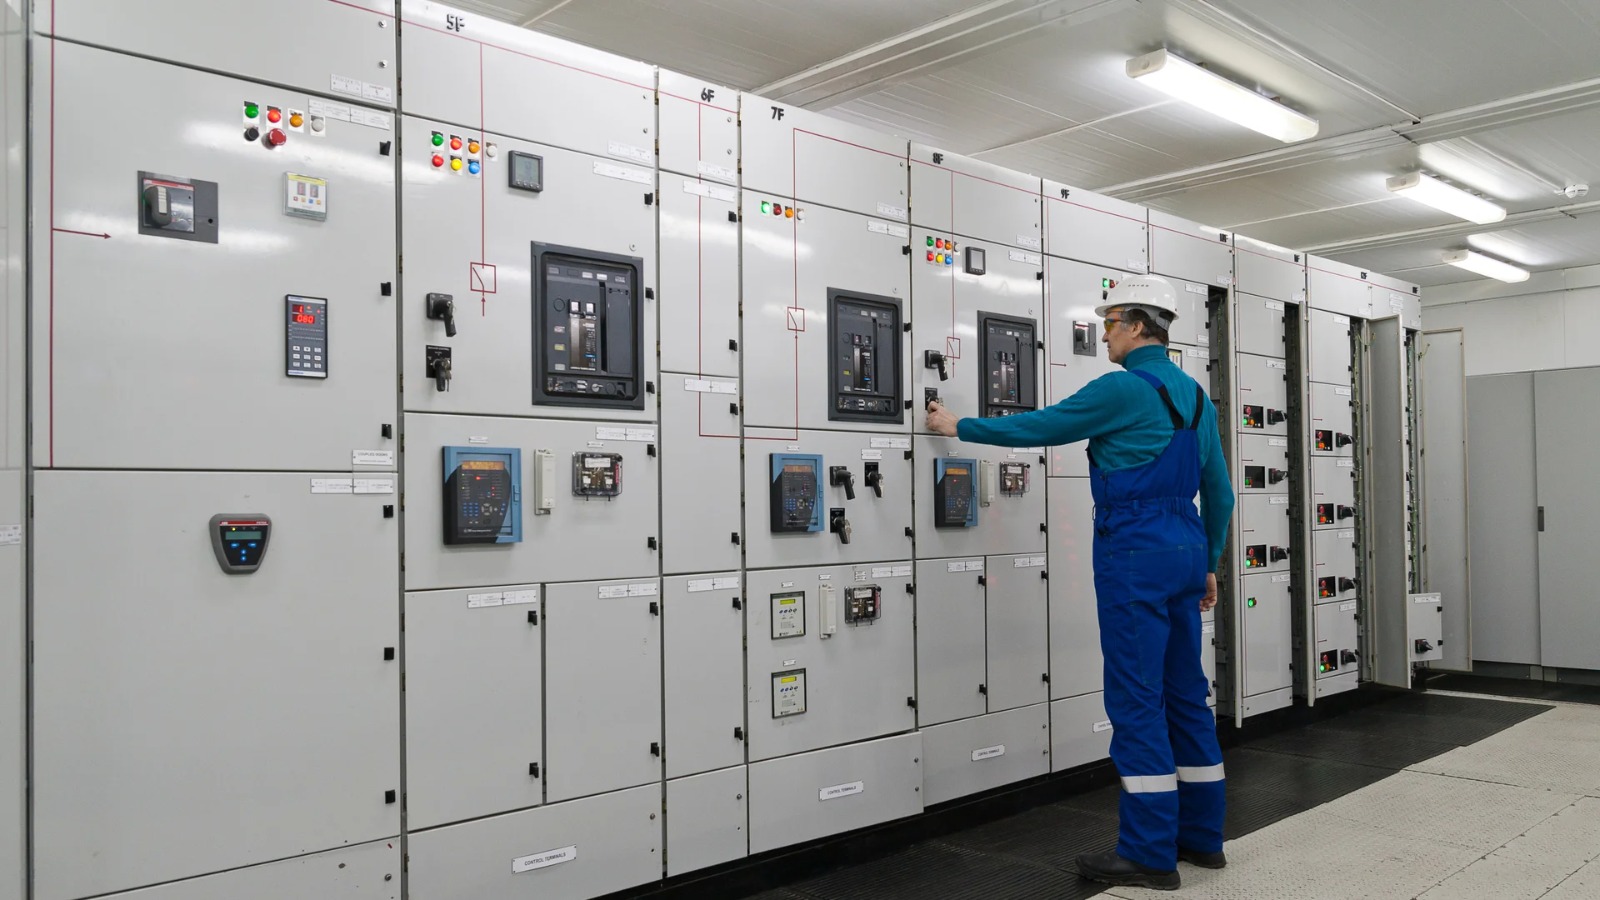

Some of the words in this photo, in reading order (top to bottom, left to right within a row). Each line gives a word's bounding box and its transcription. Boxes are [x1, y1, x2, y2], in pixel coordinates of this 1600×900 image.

[446, 14, 465, 32] 5F
[700, 87, 715, 103] 6F
[771, 106, 784, 121] 7F
[932, 152, 944, 165] 8F
[1060, 188, 1070, 199] 9F
[524, 857, 544, 867] CONTROL
[544, 851, 567, 861] TERMINALS
